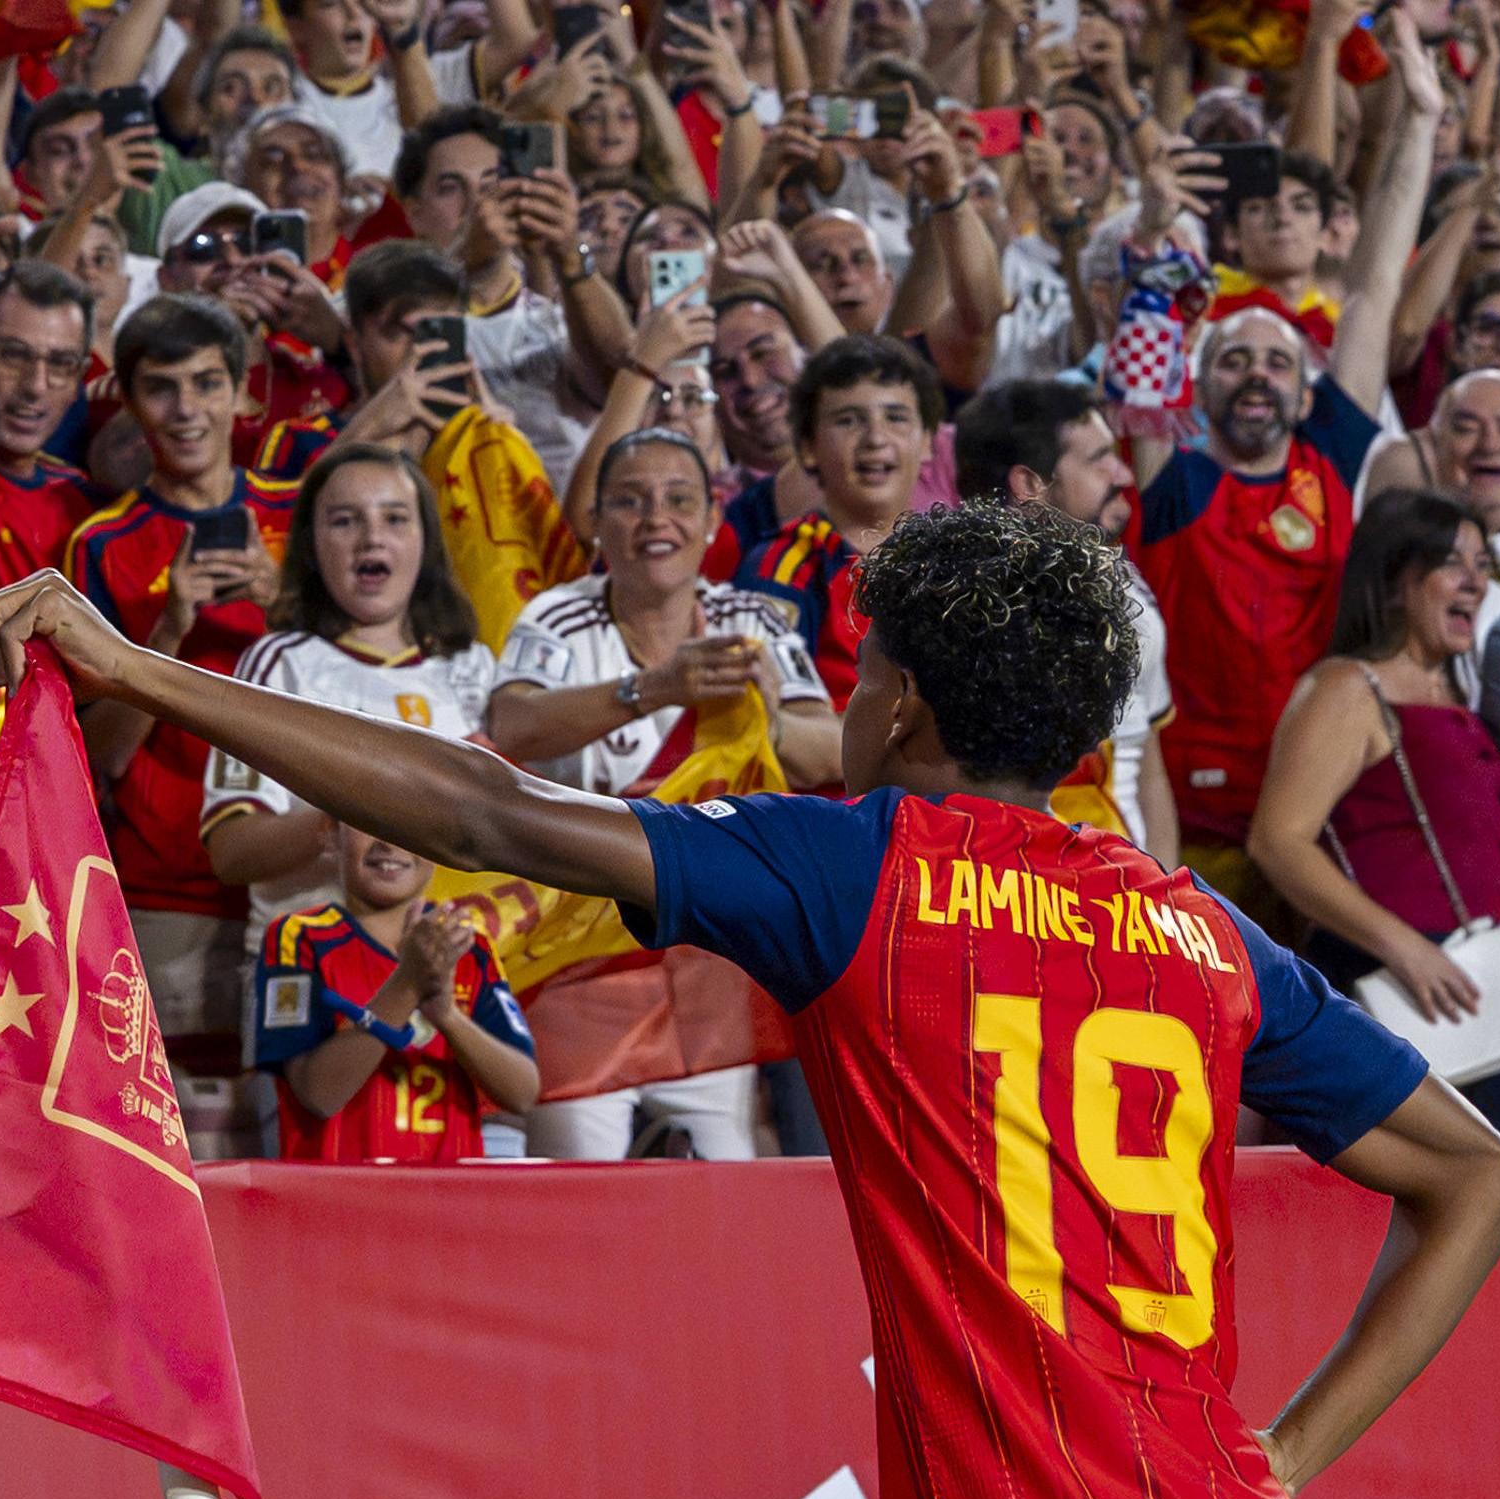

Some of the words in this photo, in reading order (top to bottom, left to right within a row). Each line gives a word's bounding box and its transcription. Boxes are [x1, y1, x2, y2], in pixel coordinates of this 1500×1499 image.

[915, 857, 1095, 946] LAMINE
[1088, 890, 1237, 973] YAMAL
[394, 1063, 445, 1133] 12
[973, 993, 1218, 1350] 19
